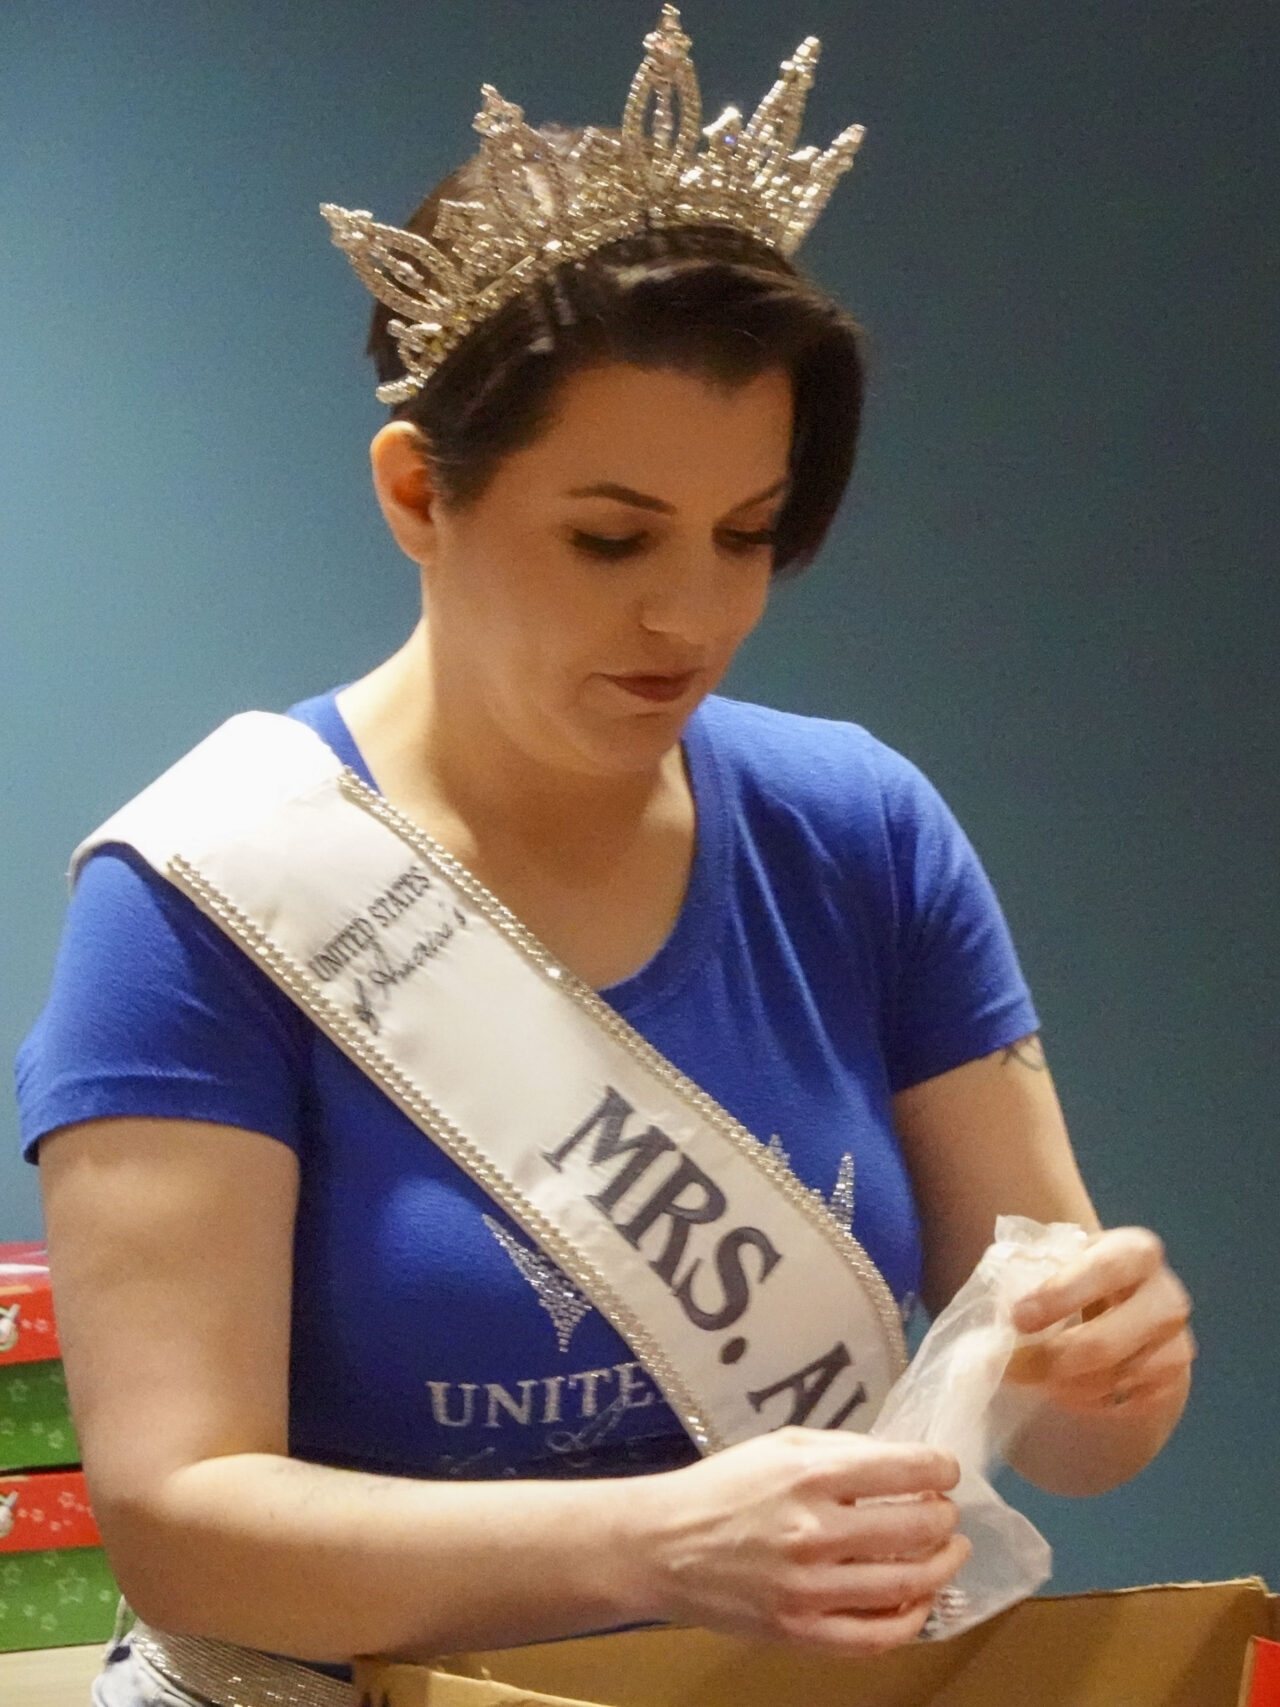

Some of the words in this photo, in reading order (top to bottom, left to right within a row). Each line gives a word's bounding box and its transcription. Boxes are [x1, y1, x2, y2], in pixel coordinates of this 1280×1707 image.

[308, 917, 376, 982] UNITED
[368, 866, 430, 928] STATES
[543, 1085, 782, 1364] MRS.
[425, 1361, 655, 1428] UNITE
